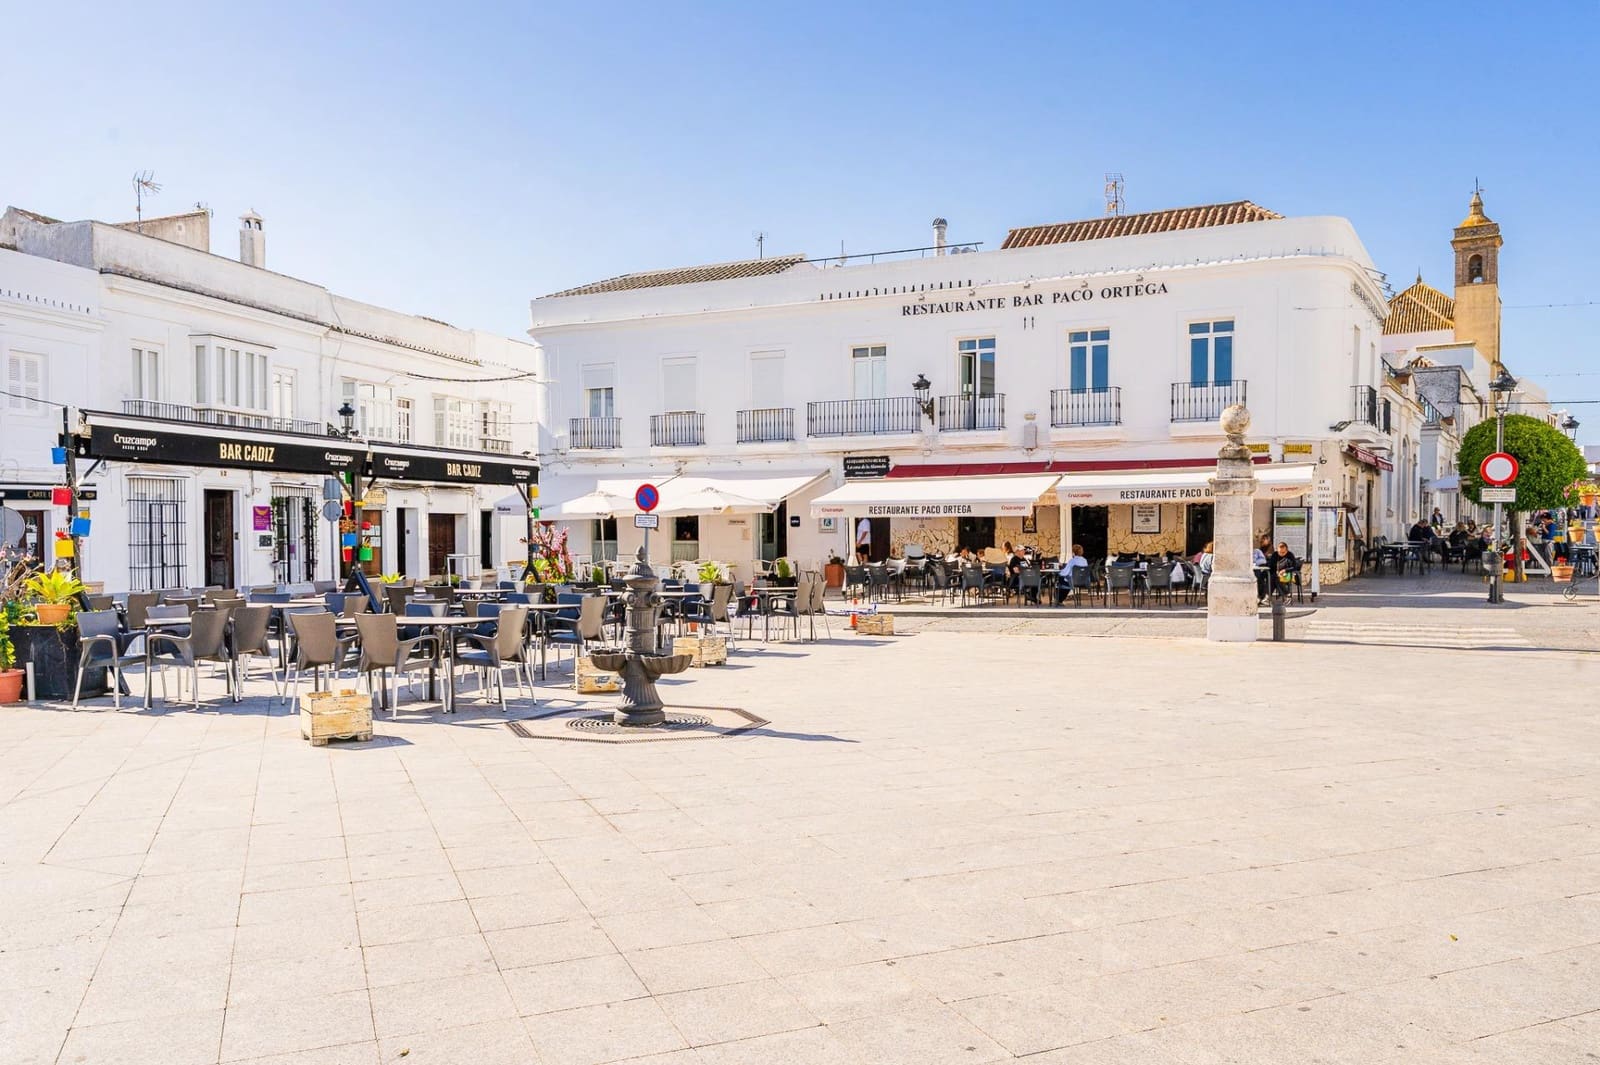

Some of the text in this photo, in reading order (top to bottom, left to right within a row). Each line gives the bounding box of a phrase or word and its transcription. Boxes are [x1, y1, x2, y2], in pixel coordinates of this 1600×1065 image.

[902, 282, 1168, 316] RESTAURANTE BAR PACO ORTEGA
[113, 433, 157, 447] Cruzcampo
[219, 442, 275, 463] BAR CADIZ
[446, 463, 482, 478] BAR CADIZ
[1120, 489, 1177, 499] RESTAURANTE
[1180, 488, 1202, 498] PACO
[868, 505, 919, 515] RESTAURANTE
[921, 505, 941, 514] PACO
[943, 504, 972, 514] ORTEGA
